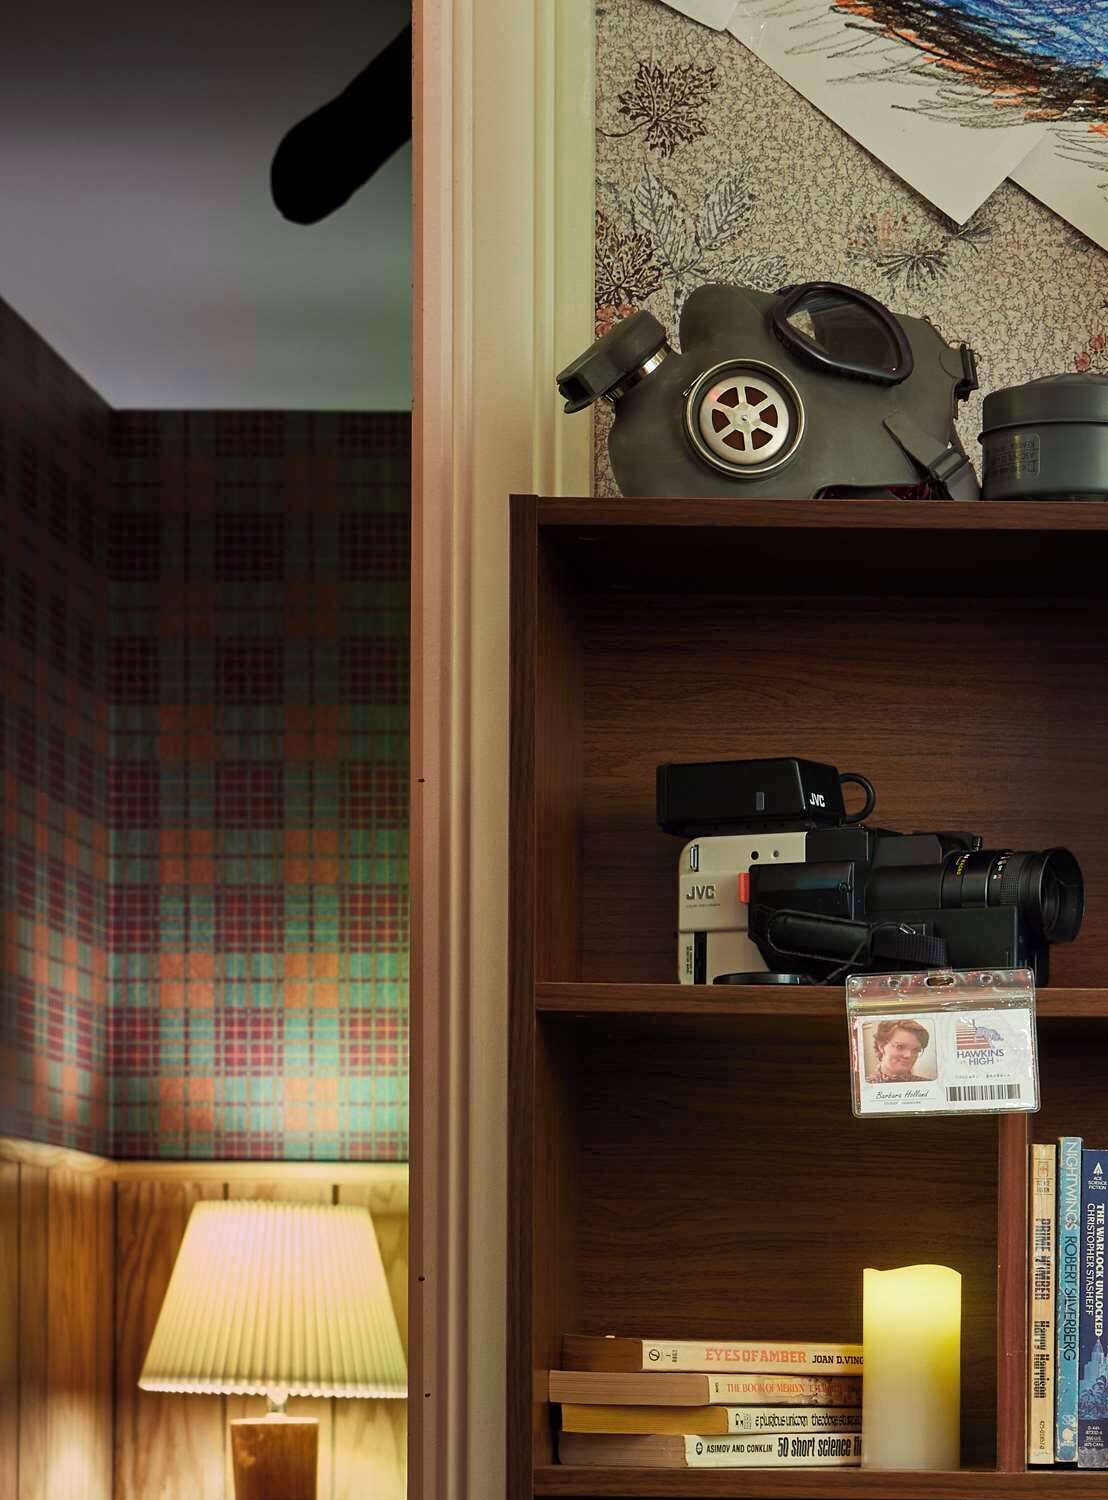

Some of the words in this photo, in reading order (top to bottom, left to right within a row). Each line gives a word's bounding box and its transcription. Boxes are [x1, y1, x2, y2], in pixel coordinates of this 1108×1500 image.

[808, 792, 826, 809] JVC
[686, 885, 715, 900] JVC
[956, 1048, 1004, 1059] HAWKINS
[968, 1057, 994, 1066] HIGH
[1065, 1142, 1080, 1231] NIGHTWINGS
[1096, 1203, 1105, 1225] THE
[1086, 1203, 1096, 1269] CHRISTOPHER
[1064, 1235, 1078, 1283] ROBERT
[1095, 1226, 1105, 1276] WARLOCK
[1085, 1270, 1095, 1315] STASHEFF
[1094, 1277, 1104, 1337] UNLOCKED
[1063, 1287, 1077, 1361] SILVERBERG
[706, 1348, 740, 1362] EYES
[742, 1350, 759, 1362] OF
[760, 1350, 806, 1363] AMBER
[812, 1355, 834, 1365] JOAN
[707, 1444, 730, 1453] ASIMOV
[732, 1444, 745, 1453] AND
[747, 1444, 773, 1453] CONKLIN
[777, 1437, 789, 1457] 50
[791, 1436, 815, 1457] short
[817, 1436, 851, 1457] science
